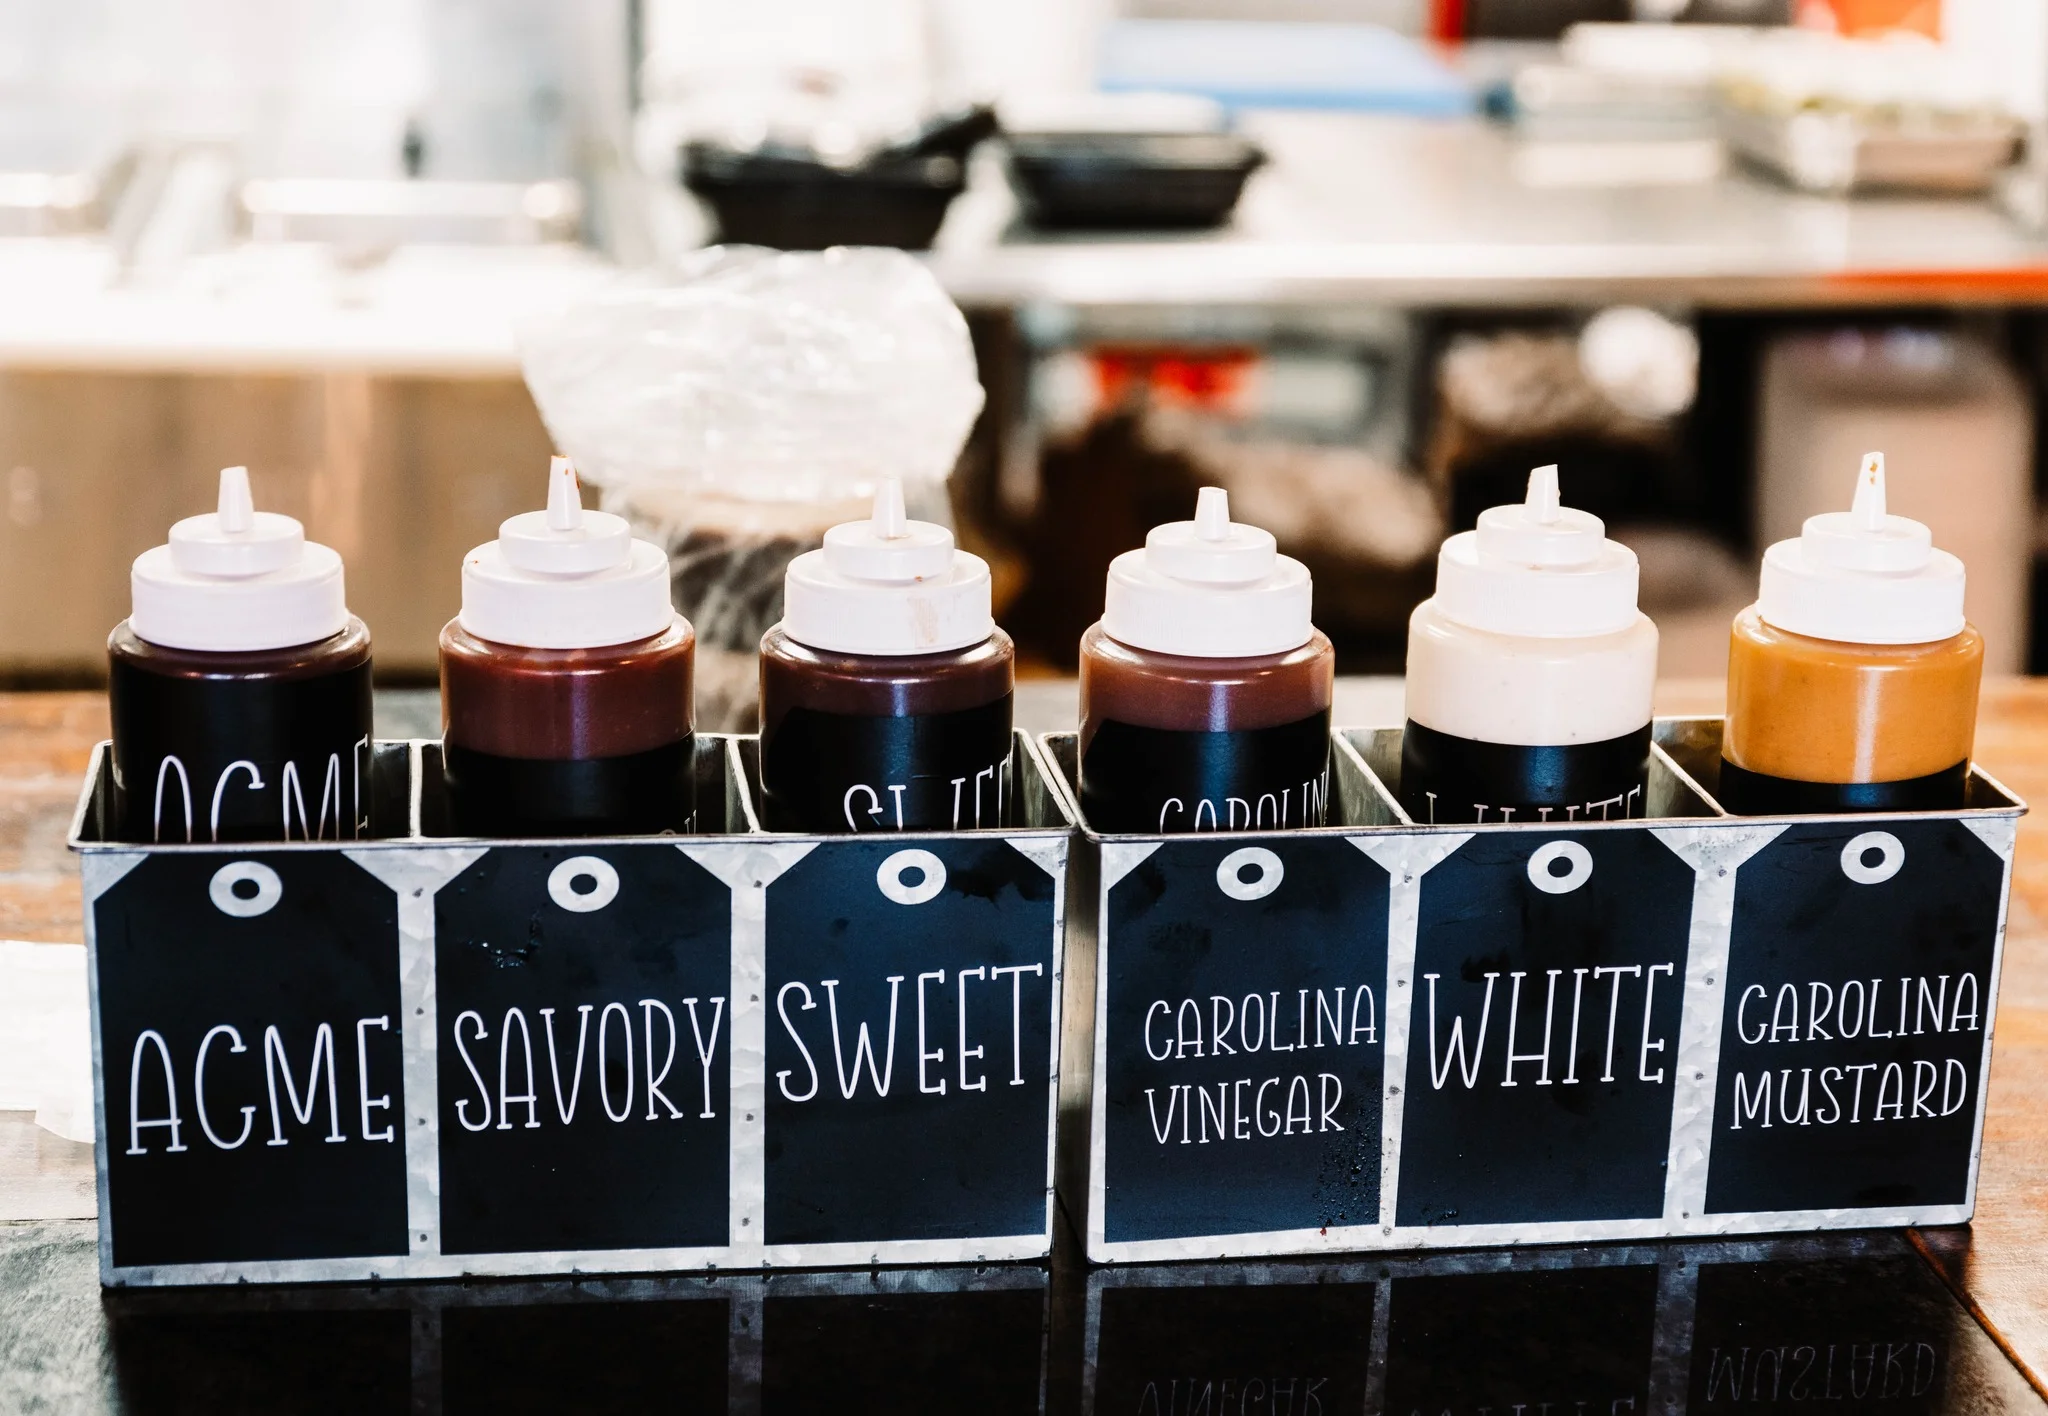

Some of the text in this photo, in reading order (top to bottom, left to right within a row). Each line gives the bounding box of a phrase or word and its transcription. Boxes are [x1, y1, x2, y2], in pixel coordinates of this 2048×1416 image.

[776, 963, 1042, 1101] SWEET
[1145, 984, 1378, 1060] CAROLINA
[1424, 962, 1674, 1090] WHITE
[1738, 972, 1979, 1044] CAROLINA
[126, 1016, 394, 1154] ACME
[454, 997, 725, 1131] SAVORY
[1144, 1073, 1344, 1144] VINEGAR
[1730, 1058, 1967, 1130] MUSTARD
